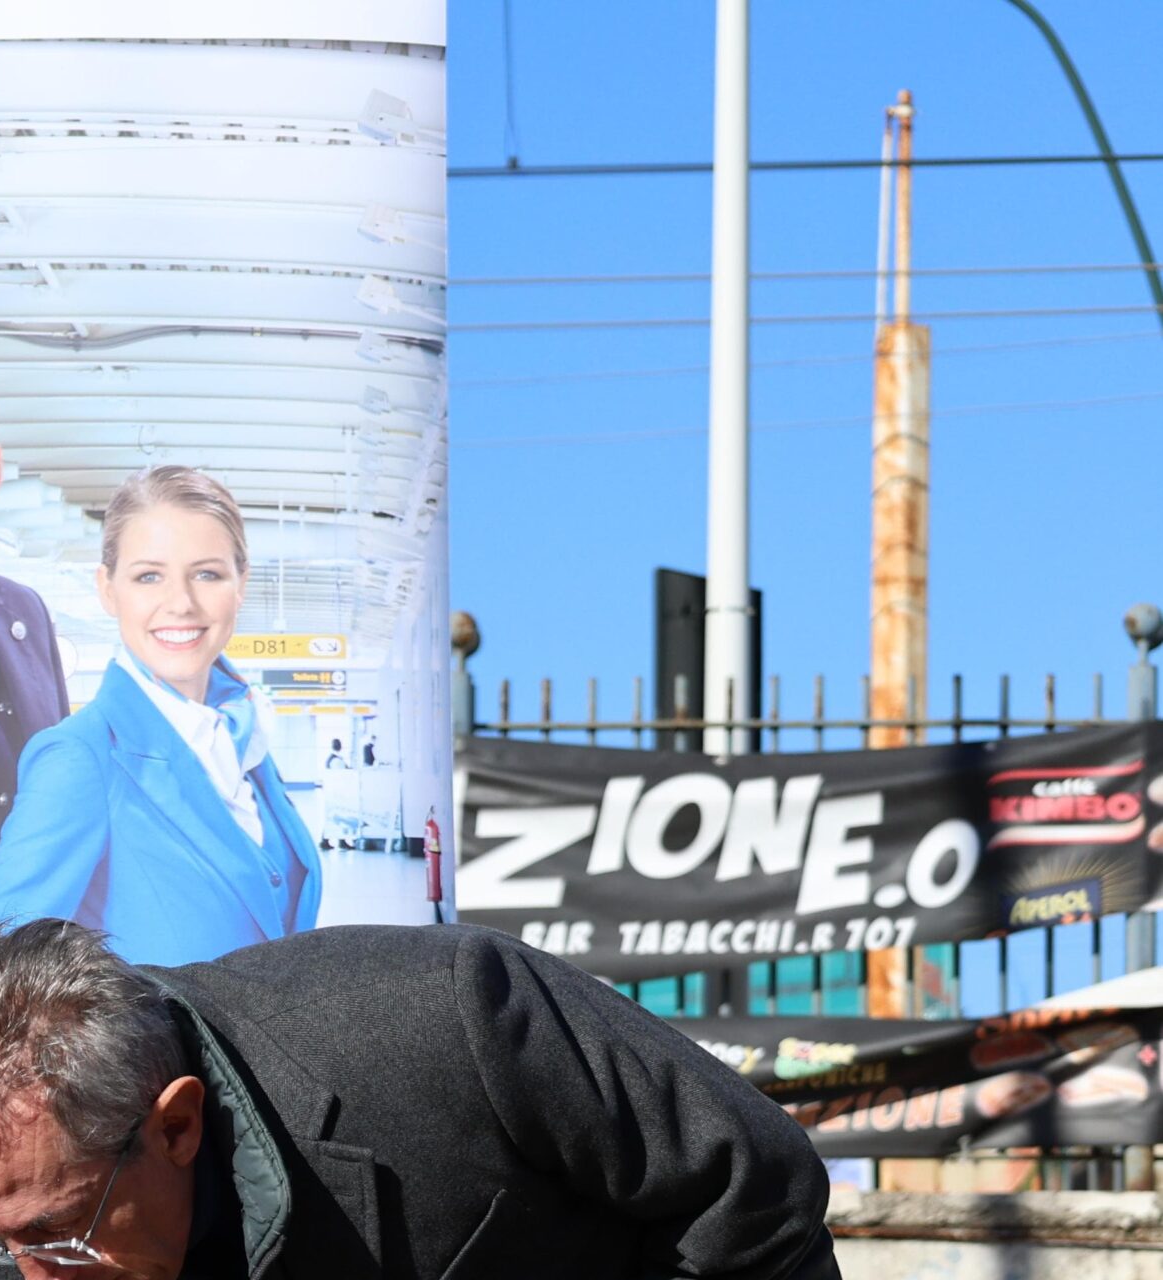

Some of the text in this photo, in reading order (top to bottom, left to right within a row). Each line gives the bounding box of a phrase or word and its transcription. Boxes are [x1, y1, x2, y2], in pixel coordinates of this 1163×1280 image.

[253, 640, 286, 654] D81
[990, 792, 1141, 822] KIMBO
[454, 768, 980, 916] ZIONE.O
[521, 920, 594, 955] BAR
